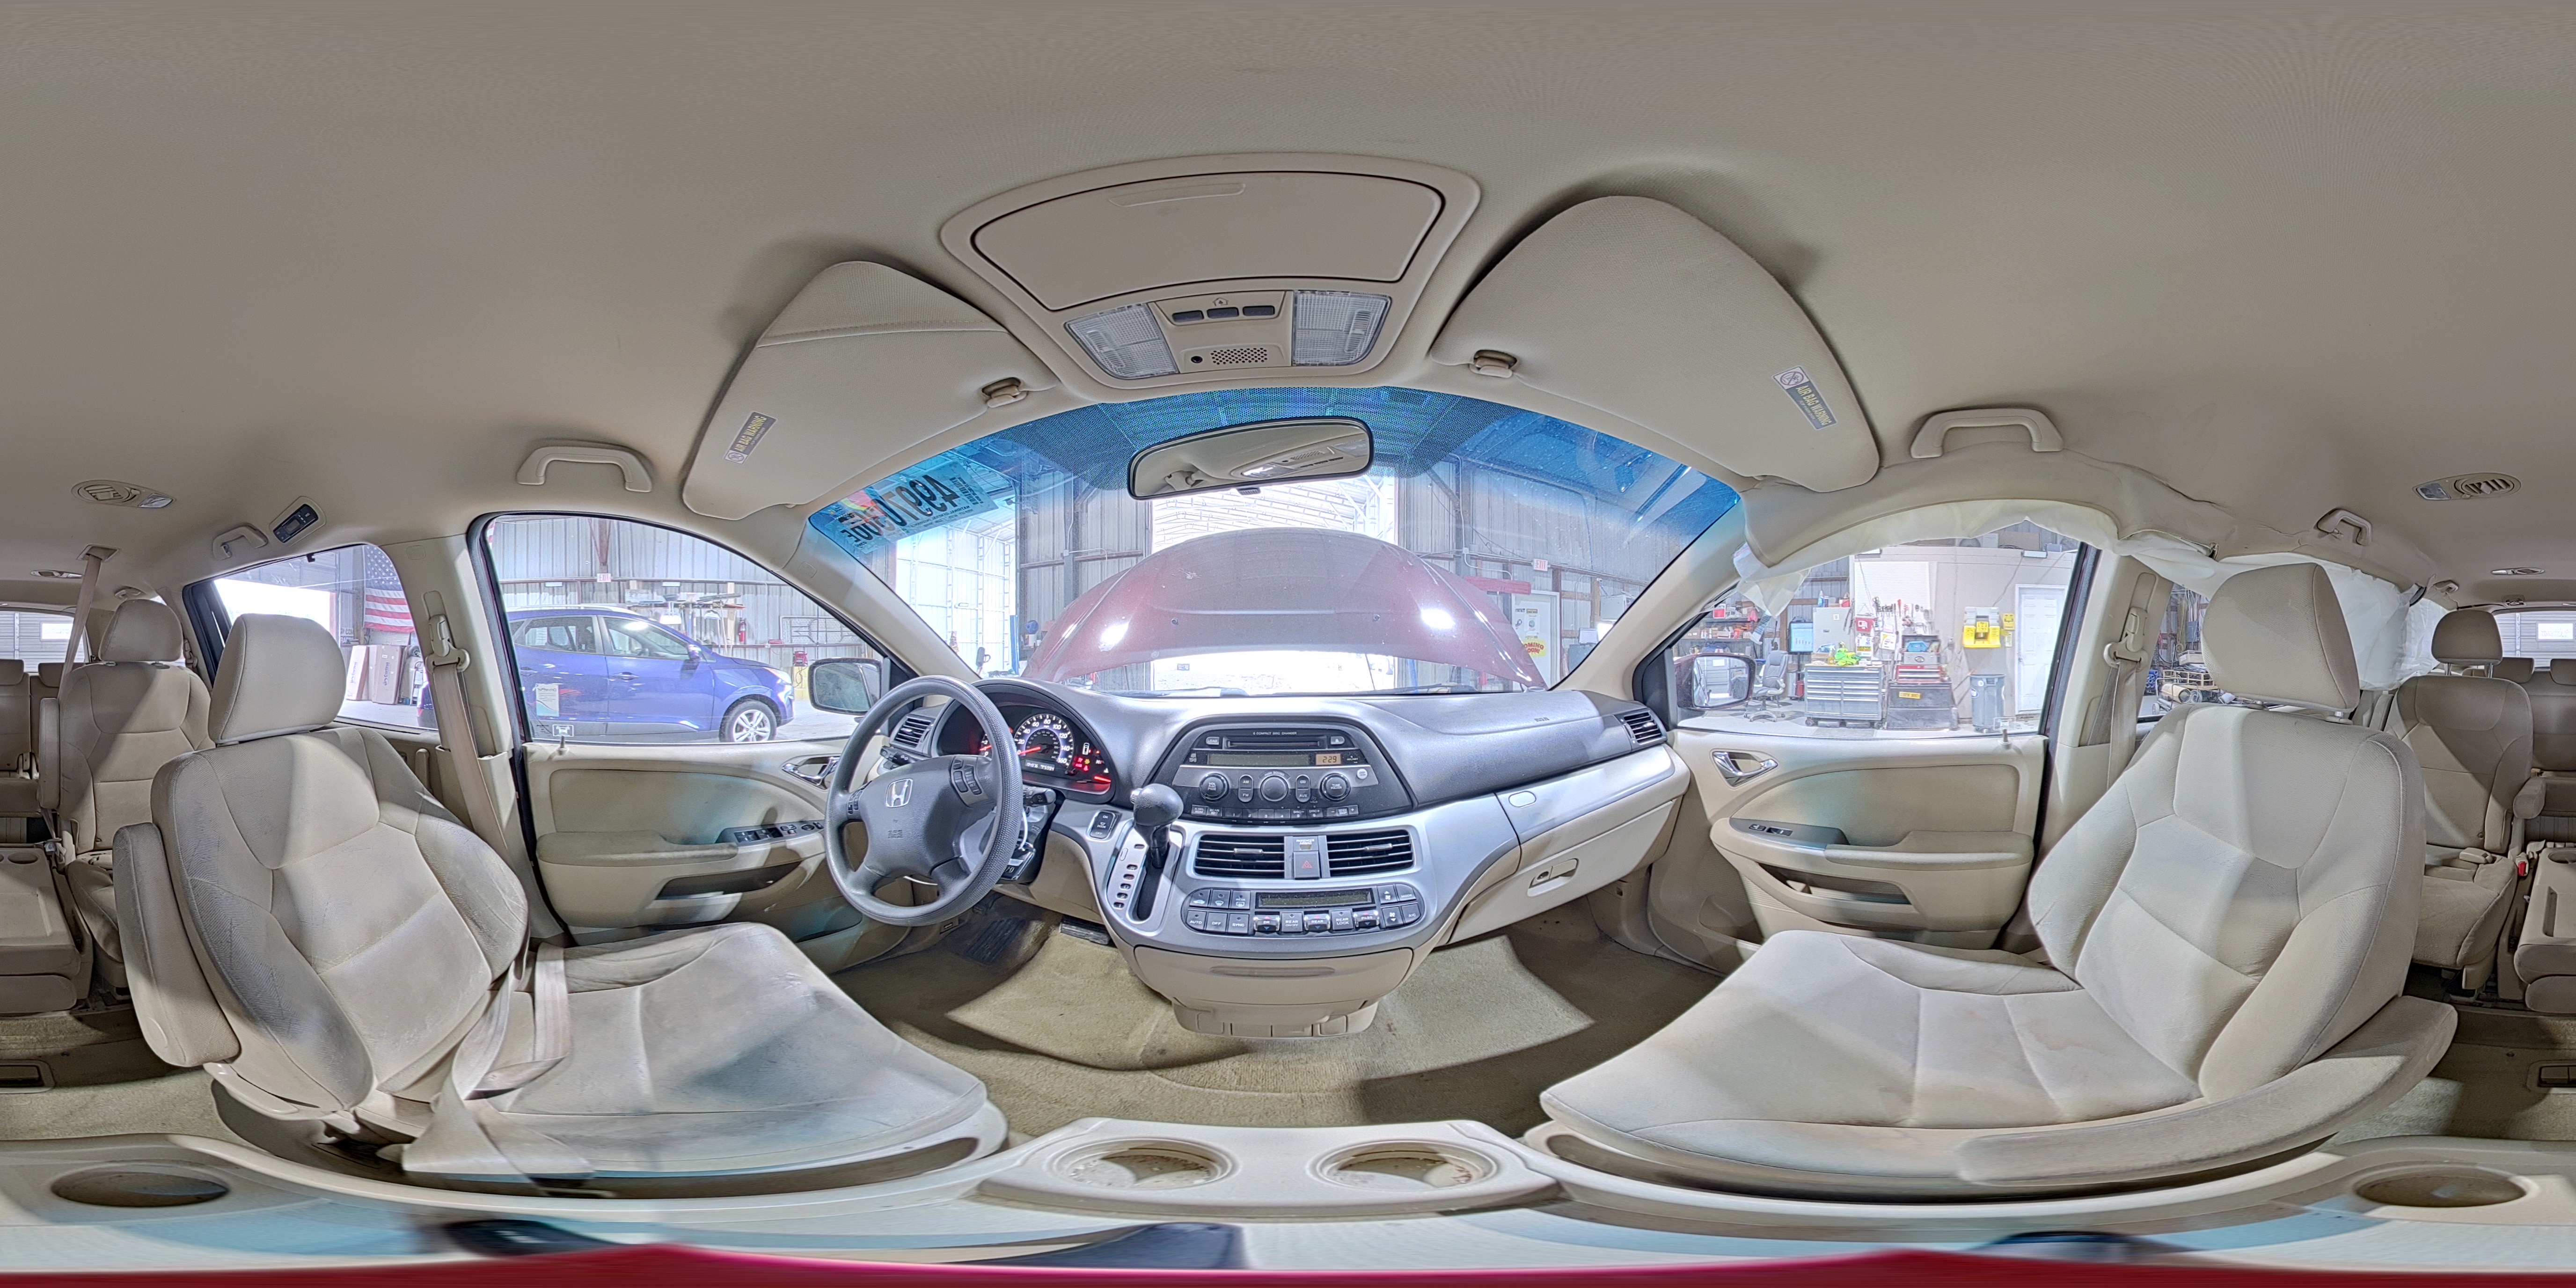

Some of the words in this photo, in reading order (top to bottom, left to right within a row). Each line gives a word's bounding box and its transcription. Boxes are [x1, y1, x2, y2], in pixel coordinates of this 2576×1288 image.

[1795, 385, 1812, 396] AIR
[1803, 393, 1819, 406] BAG
[1810, 404, 1832, 426] WARNING
[744, 415, 767, 436] WARNING
[738, 435, 753, 445] BAG
[1537, 560, 1546, 570] EXIT
